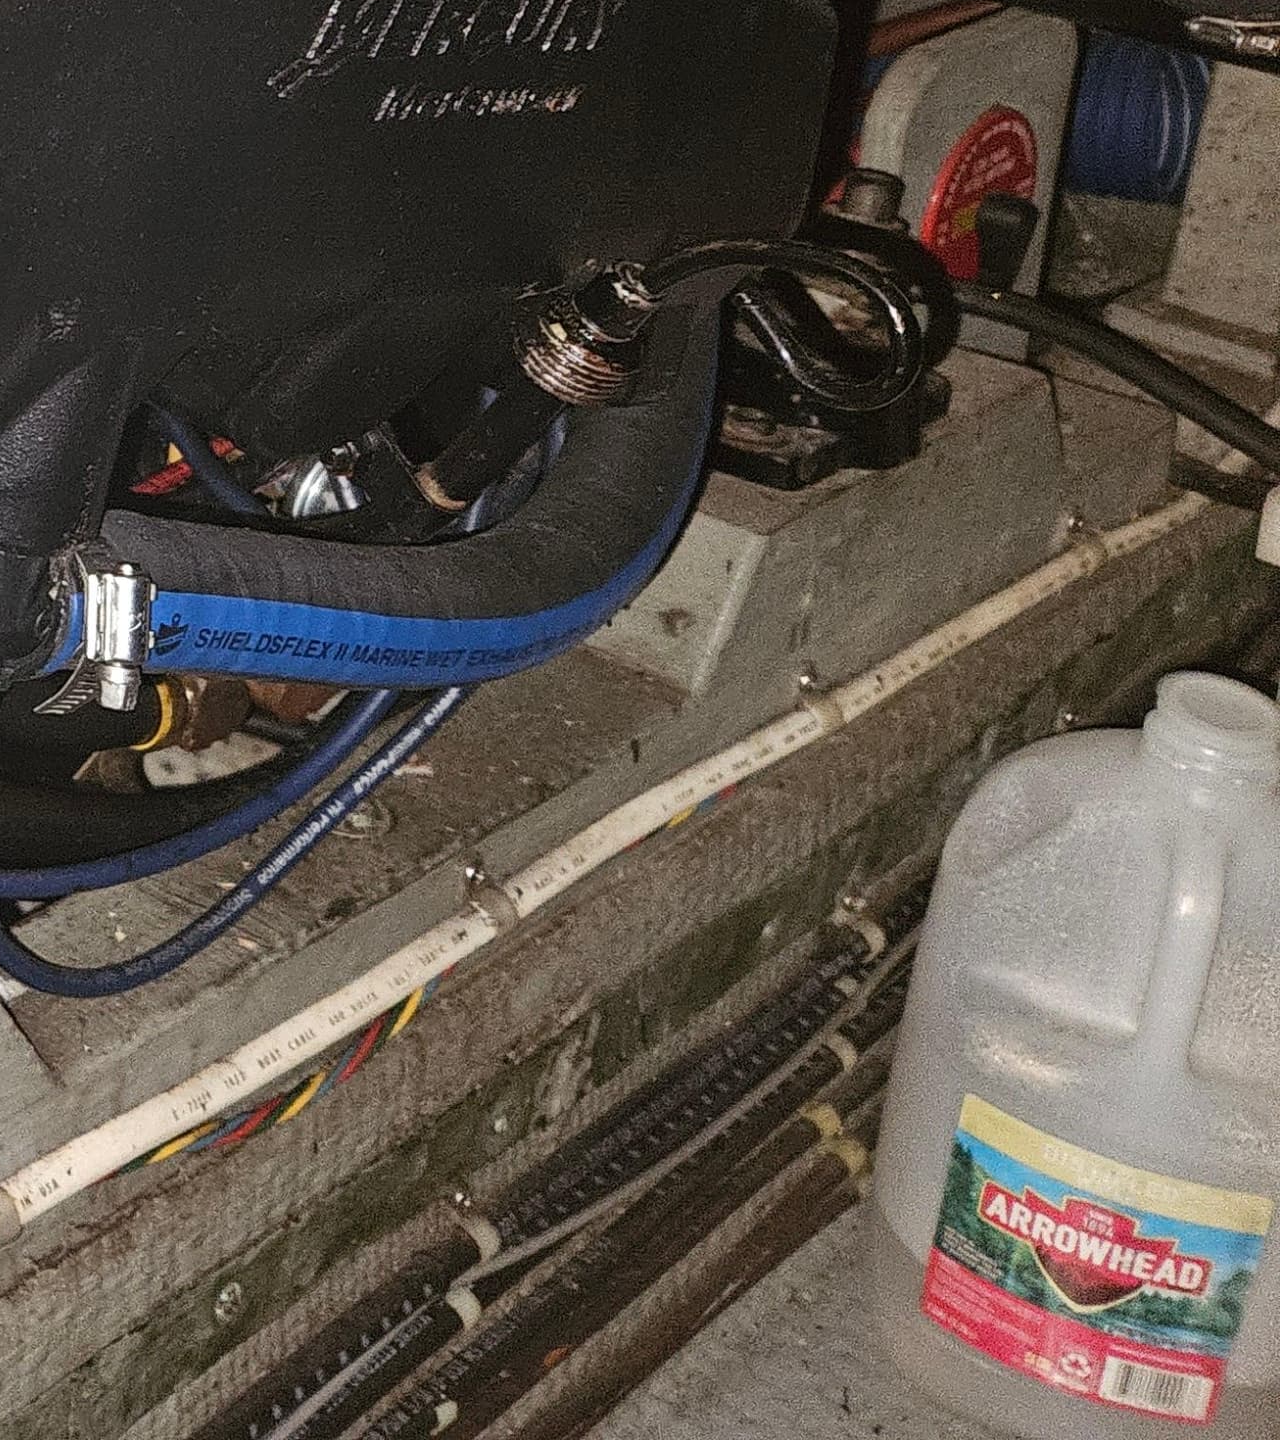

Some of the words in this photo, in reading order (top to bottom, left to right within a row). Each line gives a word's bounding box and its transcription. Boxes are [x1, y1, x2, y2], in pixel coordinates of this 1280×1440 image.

[194, 628, 331, 660] SHIELDSFLEX
[352, 644, 424, 668] MARINE
[984, 1192, 1204, 1292] ARROWHEAD
